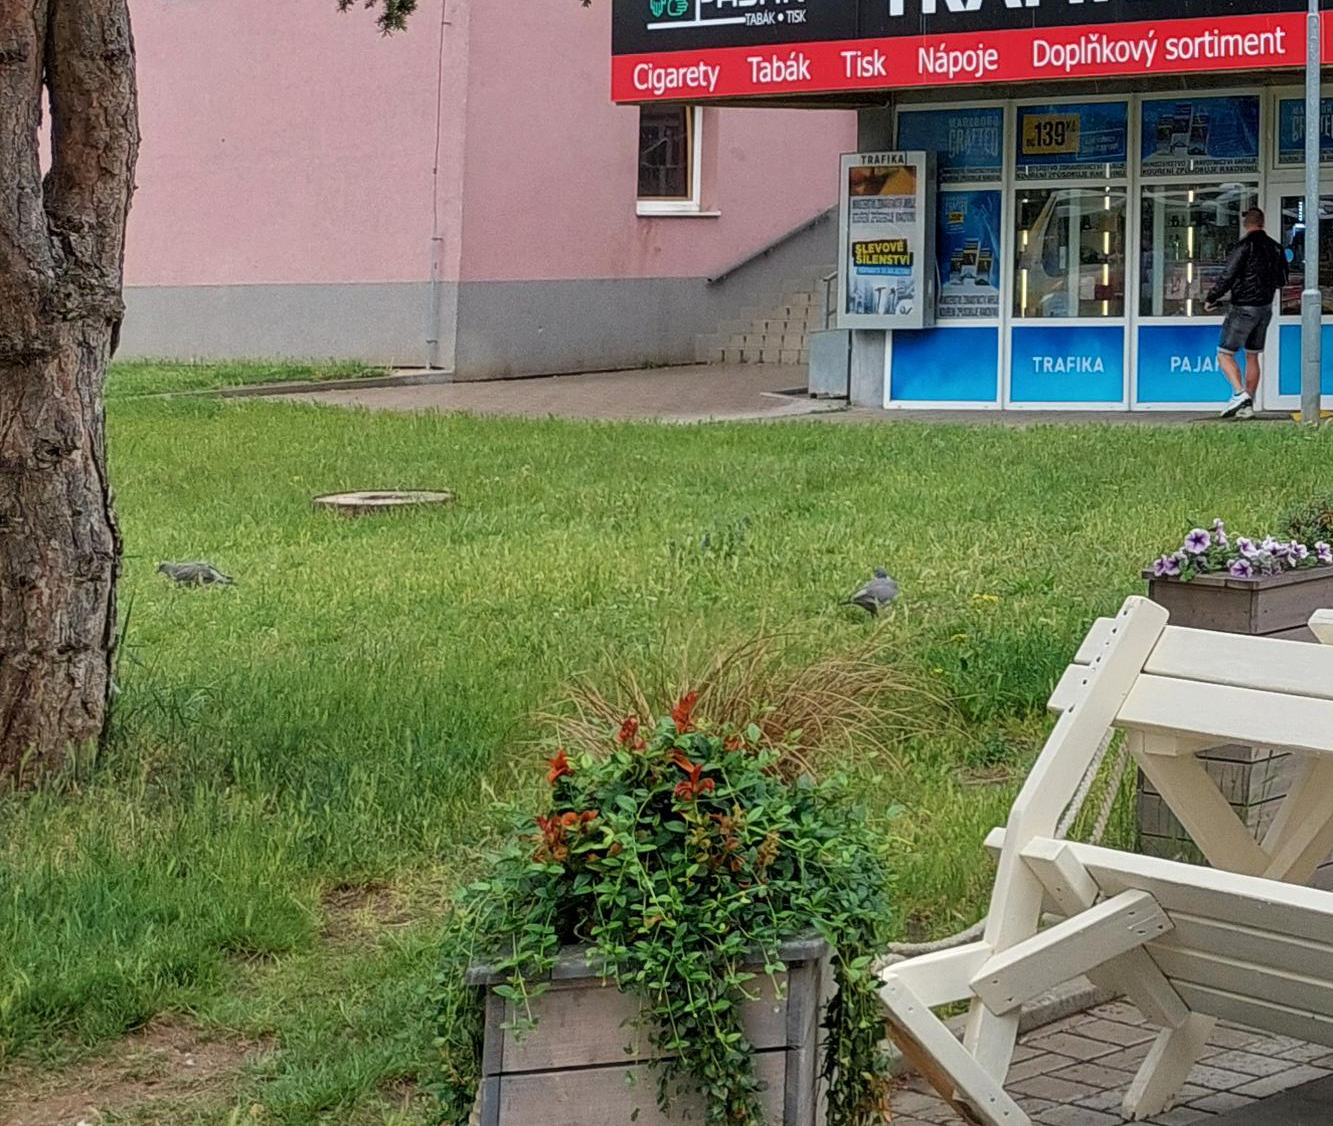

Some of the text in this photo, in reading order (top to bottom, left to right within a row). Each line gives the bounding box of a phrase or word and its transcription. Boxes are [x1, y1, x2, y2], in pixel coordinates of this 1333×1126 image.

[786, 9, 807, 23] TISK
[633, 62, 720, 96] Cigarety
[747, 51, 811, 84] Tabák
[841, 48, 887, 78] Tisk
[917, 42, 999, 78] Nápoje
[1032, 30, 1157, 72] Doplňkový
[1165, 29, 1287, 61] sortiment
[1034, 120, 1067, 148] 139
[861, 154, 905, 165] TRAFIKA
[1032, 356, 1104, 373] TRAFIKA
